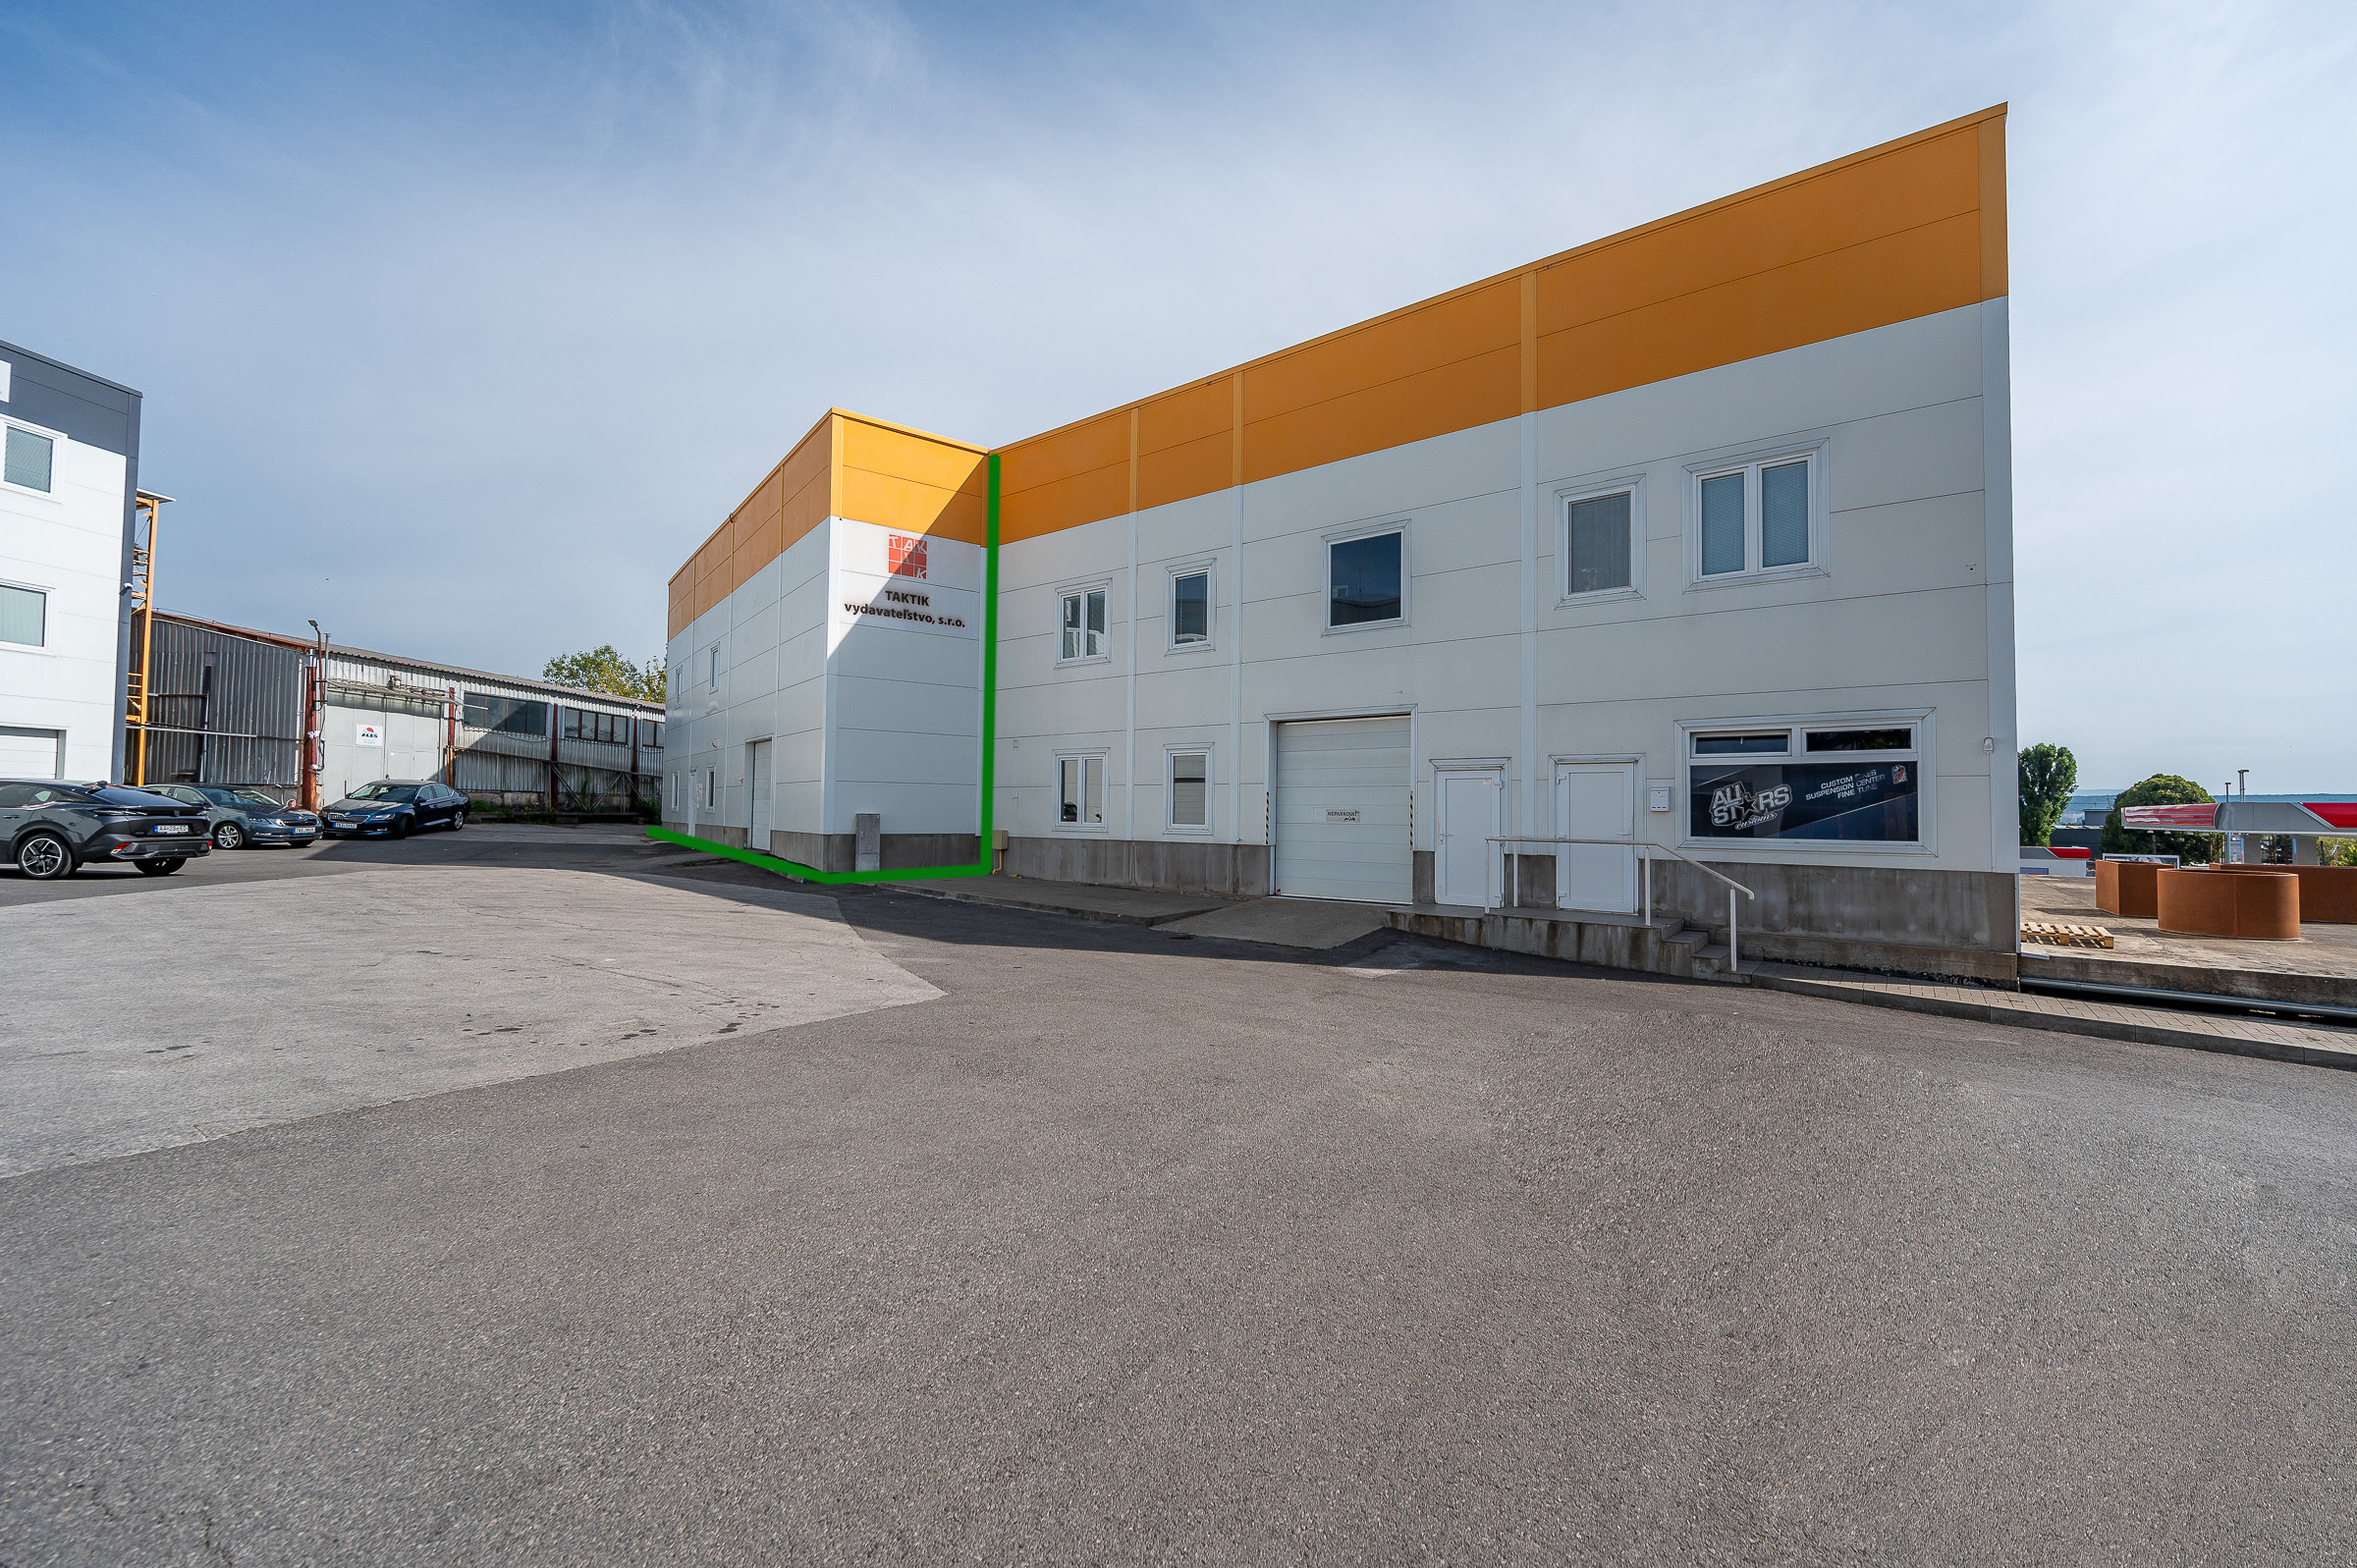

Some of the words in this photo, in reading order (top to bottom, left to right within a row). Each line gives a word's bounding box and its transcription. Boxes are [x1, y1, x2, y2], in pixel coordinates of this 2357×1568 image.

[885, 590, 930, 607] TAKTIK
[845, 603, 936, 624] vydavateľstvo,
[938, 617, 965, 628] s.r.o.
[1805, 783, 1854, 800] SUSPENSION
[1856, 774, 1886, 787] CENTER
[1821, 776, 1853, 789] CUSTOM
[1837, 788, 1855, 799] FINE
[1857, 784, 1879, 793] TUNE
